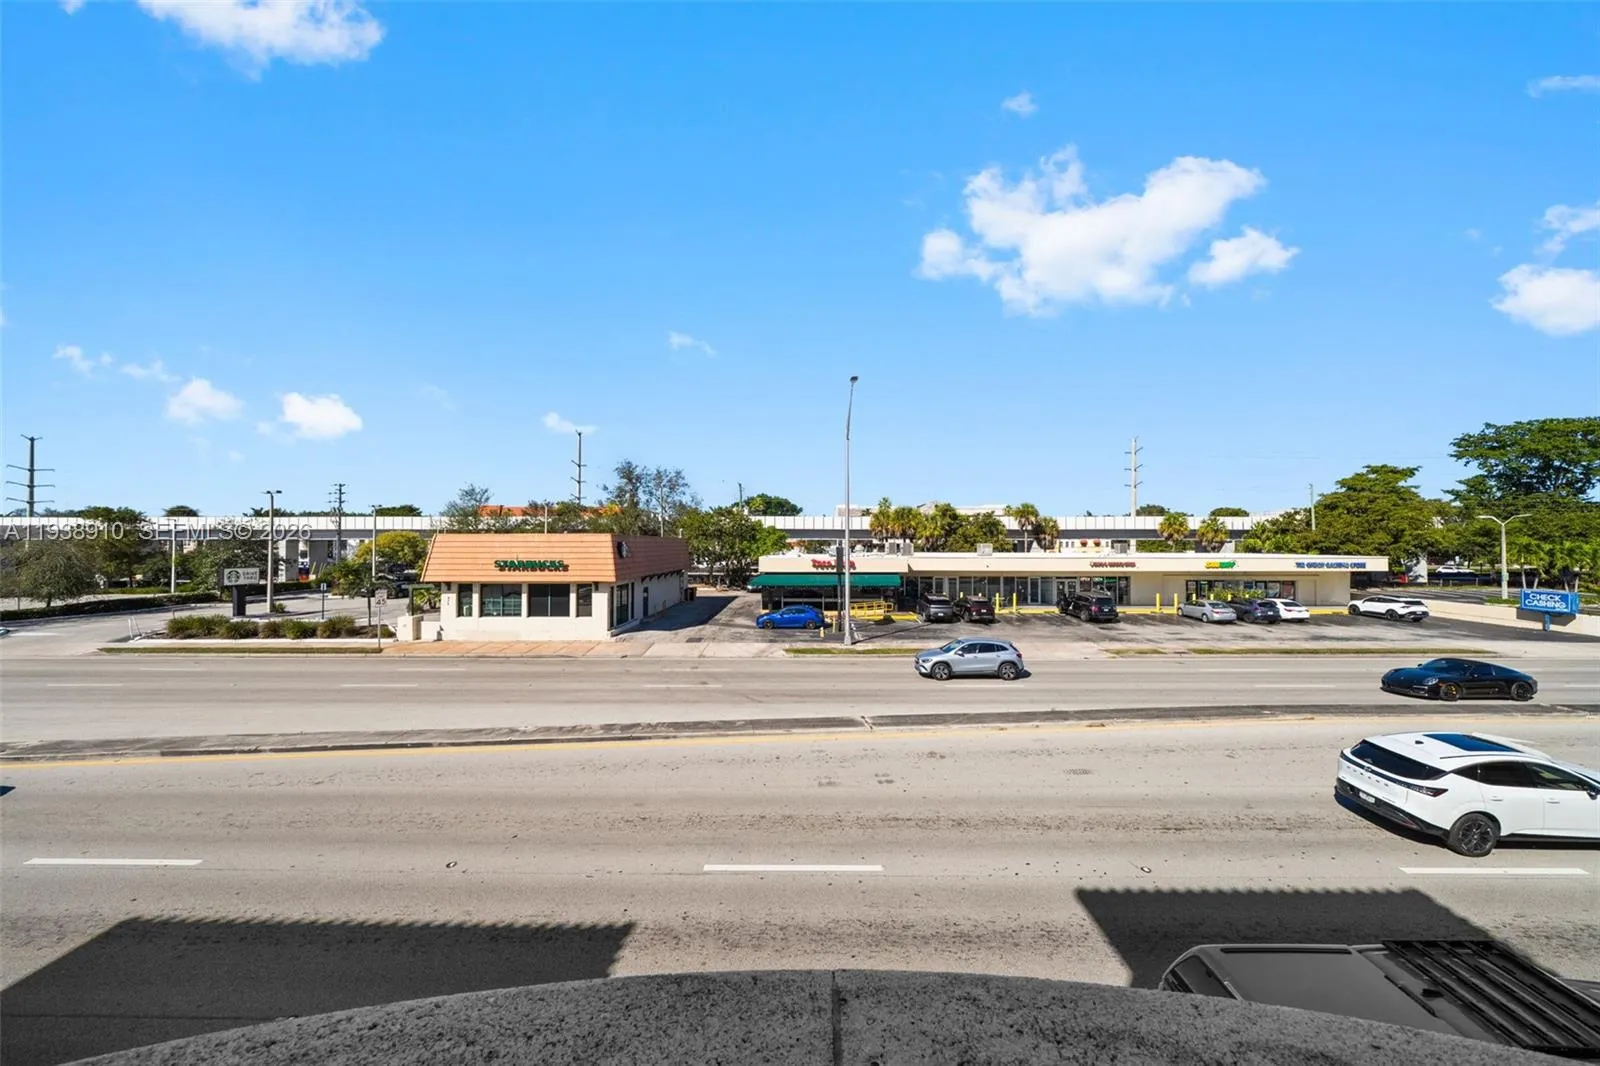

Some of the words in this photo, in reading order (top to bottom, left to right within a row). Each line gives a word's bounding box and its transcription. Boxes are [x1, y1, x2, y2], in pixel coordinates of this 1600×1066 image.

[494, 560, 566, 570] STARBUCKS
[1529, 593, 1562, 602] CHECK
[1525, 599, 1567, 609] CASHING
